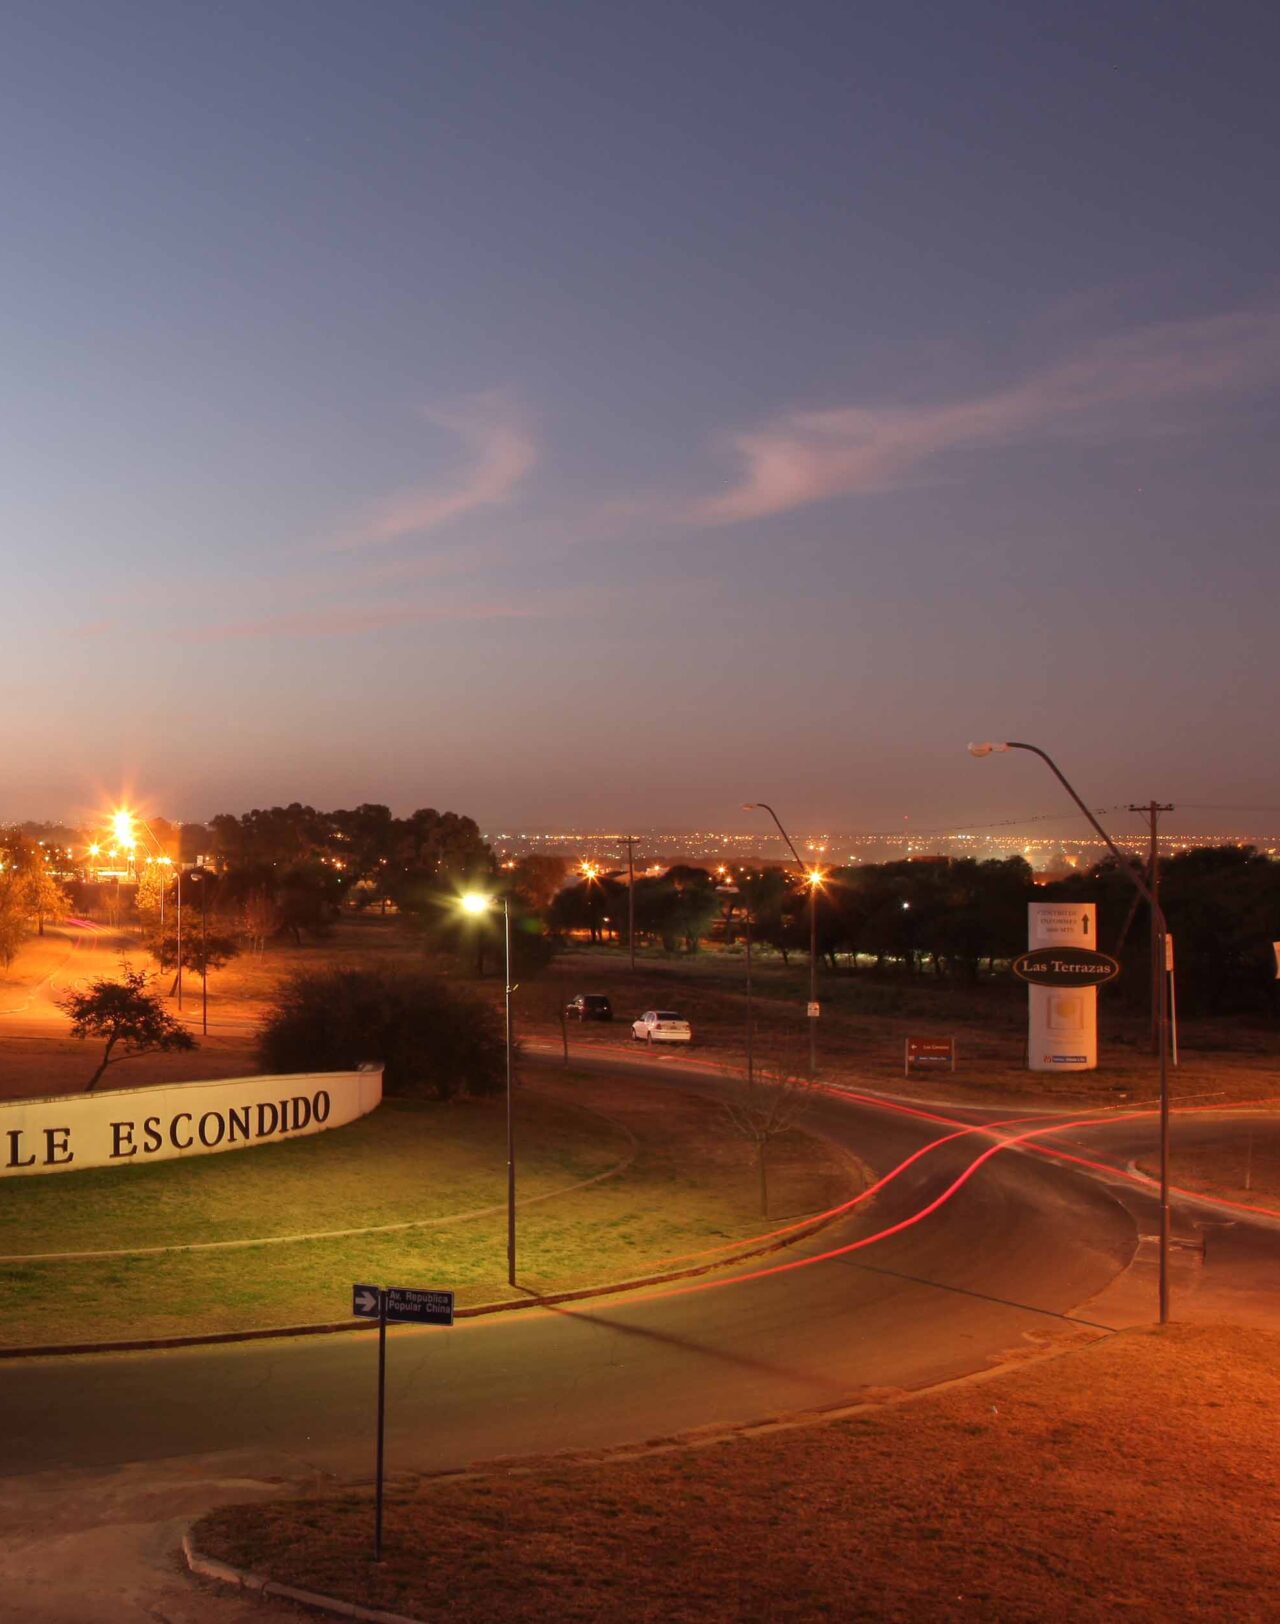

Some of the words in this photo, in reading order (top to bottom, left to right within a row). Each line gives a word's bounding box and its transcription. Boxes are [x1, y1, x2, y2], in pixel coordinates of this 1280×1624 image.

[1023, 960, 1047, 972] Las
[1051, 960, 1111, 974] Terrazas
[109, 1090, 331, 1158] ESCONDIDO
[388, 1300, 422, 1312] Popular
[426, 1303, 451, 1314] China
